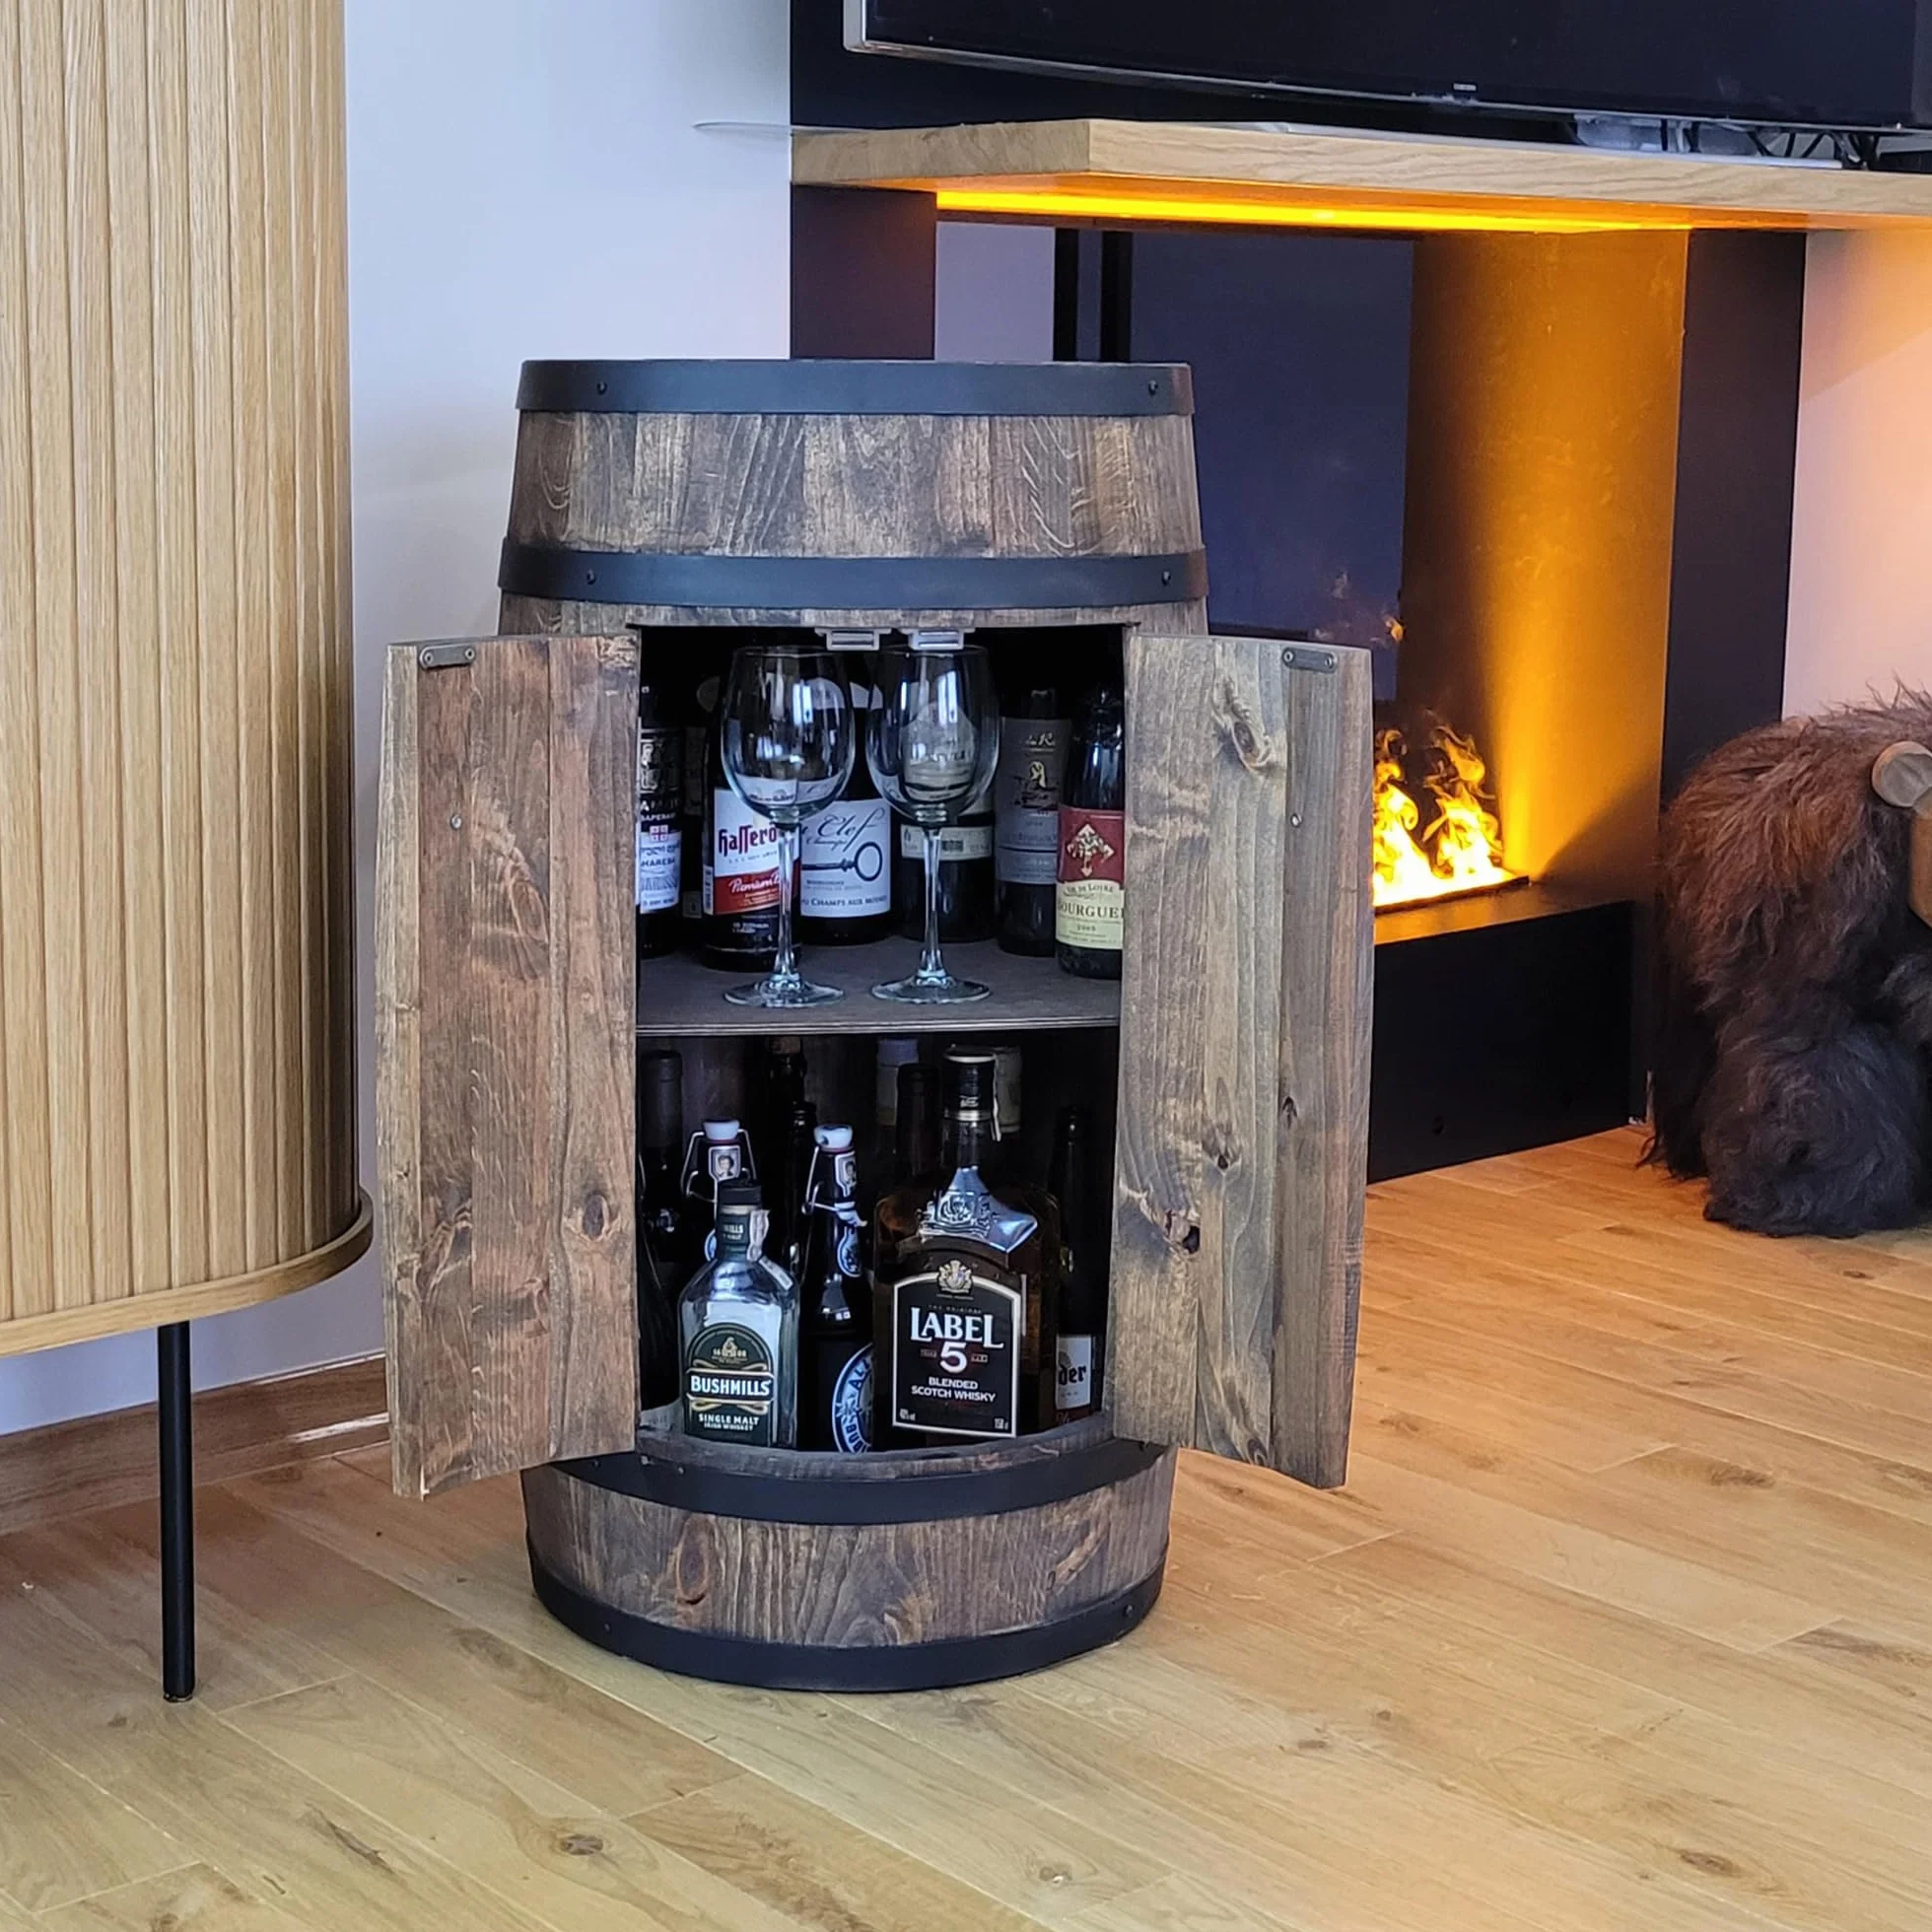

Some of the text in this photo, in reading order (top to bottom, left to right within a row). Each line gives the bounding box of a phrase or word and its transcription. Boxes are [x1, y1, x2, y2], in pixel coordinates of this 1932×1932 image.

[910, 1306, 1004, 1348] LABEL
[939, 1341, 968, 1373] 5
[690, 1375, 772, 1397] BUSHMILLS
[928, 1376, 979, 1390] BLENDED
[911, 1385, 997, 1402] SCOTCH WHISKY
[698, 1413, 760, 1425] SINGLE MALT
